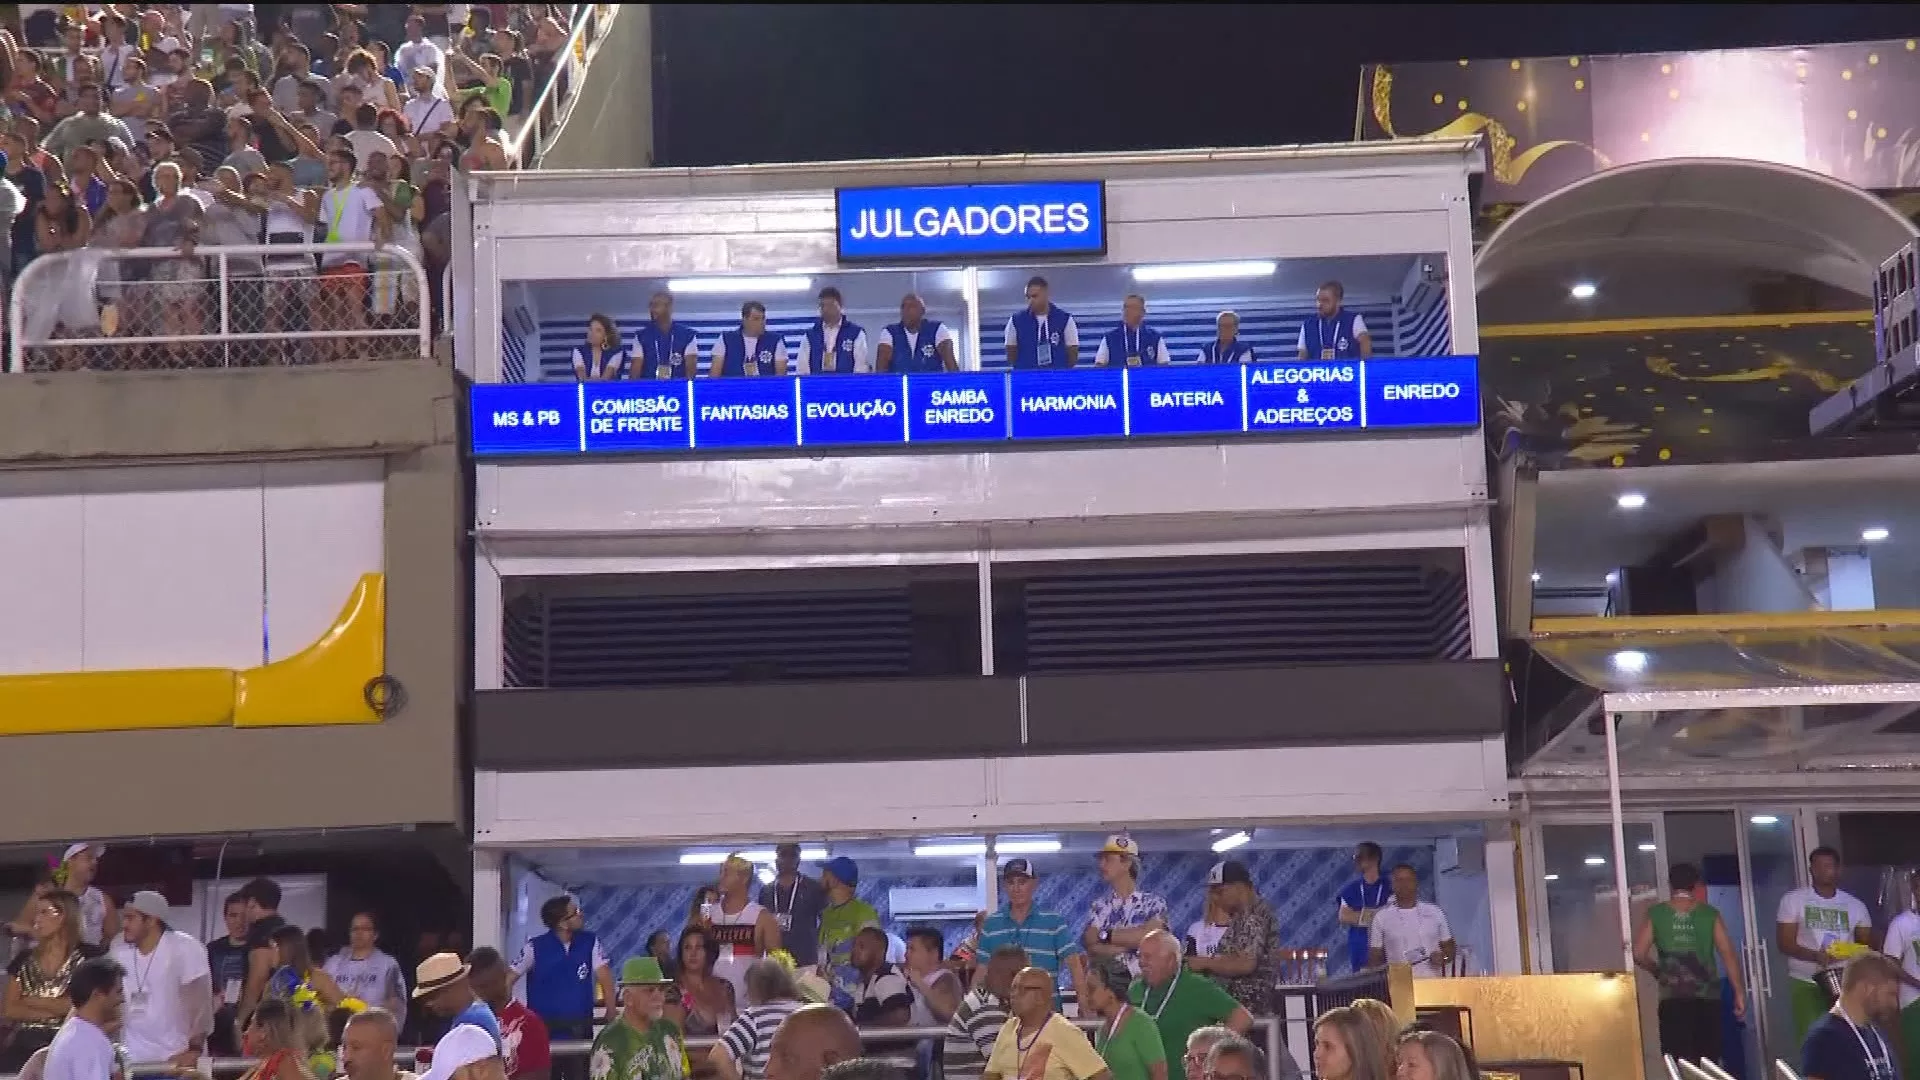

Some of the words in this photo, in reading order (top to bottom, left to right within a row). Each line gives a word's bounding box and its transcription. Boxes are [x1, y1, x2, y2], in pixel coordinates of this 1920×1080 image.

[850, 203, 1090, 239] JULGADORES
[1251, 366, 1354, 385] ALEGORIAS
[930, 389, 989, 406] SAMBA
[1149, 391, 1225, 408] BATERIA
[1297, 388, 1311, 404] &
[1383, 382, 1460, 400] ENREDO
[591, 396, 681, 416] COMISSÃO
[806, 398, 897, 423] EVOLUÇÃO
[1020, 394, 1117, 412] HARMONIA
[492, 410, 520, 428] MS
[522, 410, 536, 426] &
[537, 409, 561, 426] PB
[701, 404, 789, 422] FANTASIAS
[924, 406, 995, 424] ENREDO
[1253, 406, 1354, 427] ADEREÇOS
[590, 418, 614, 434] DE
[617, 416, 683, 433] FRENTE
